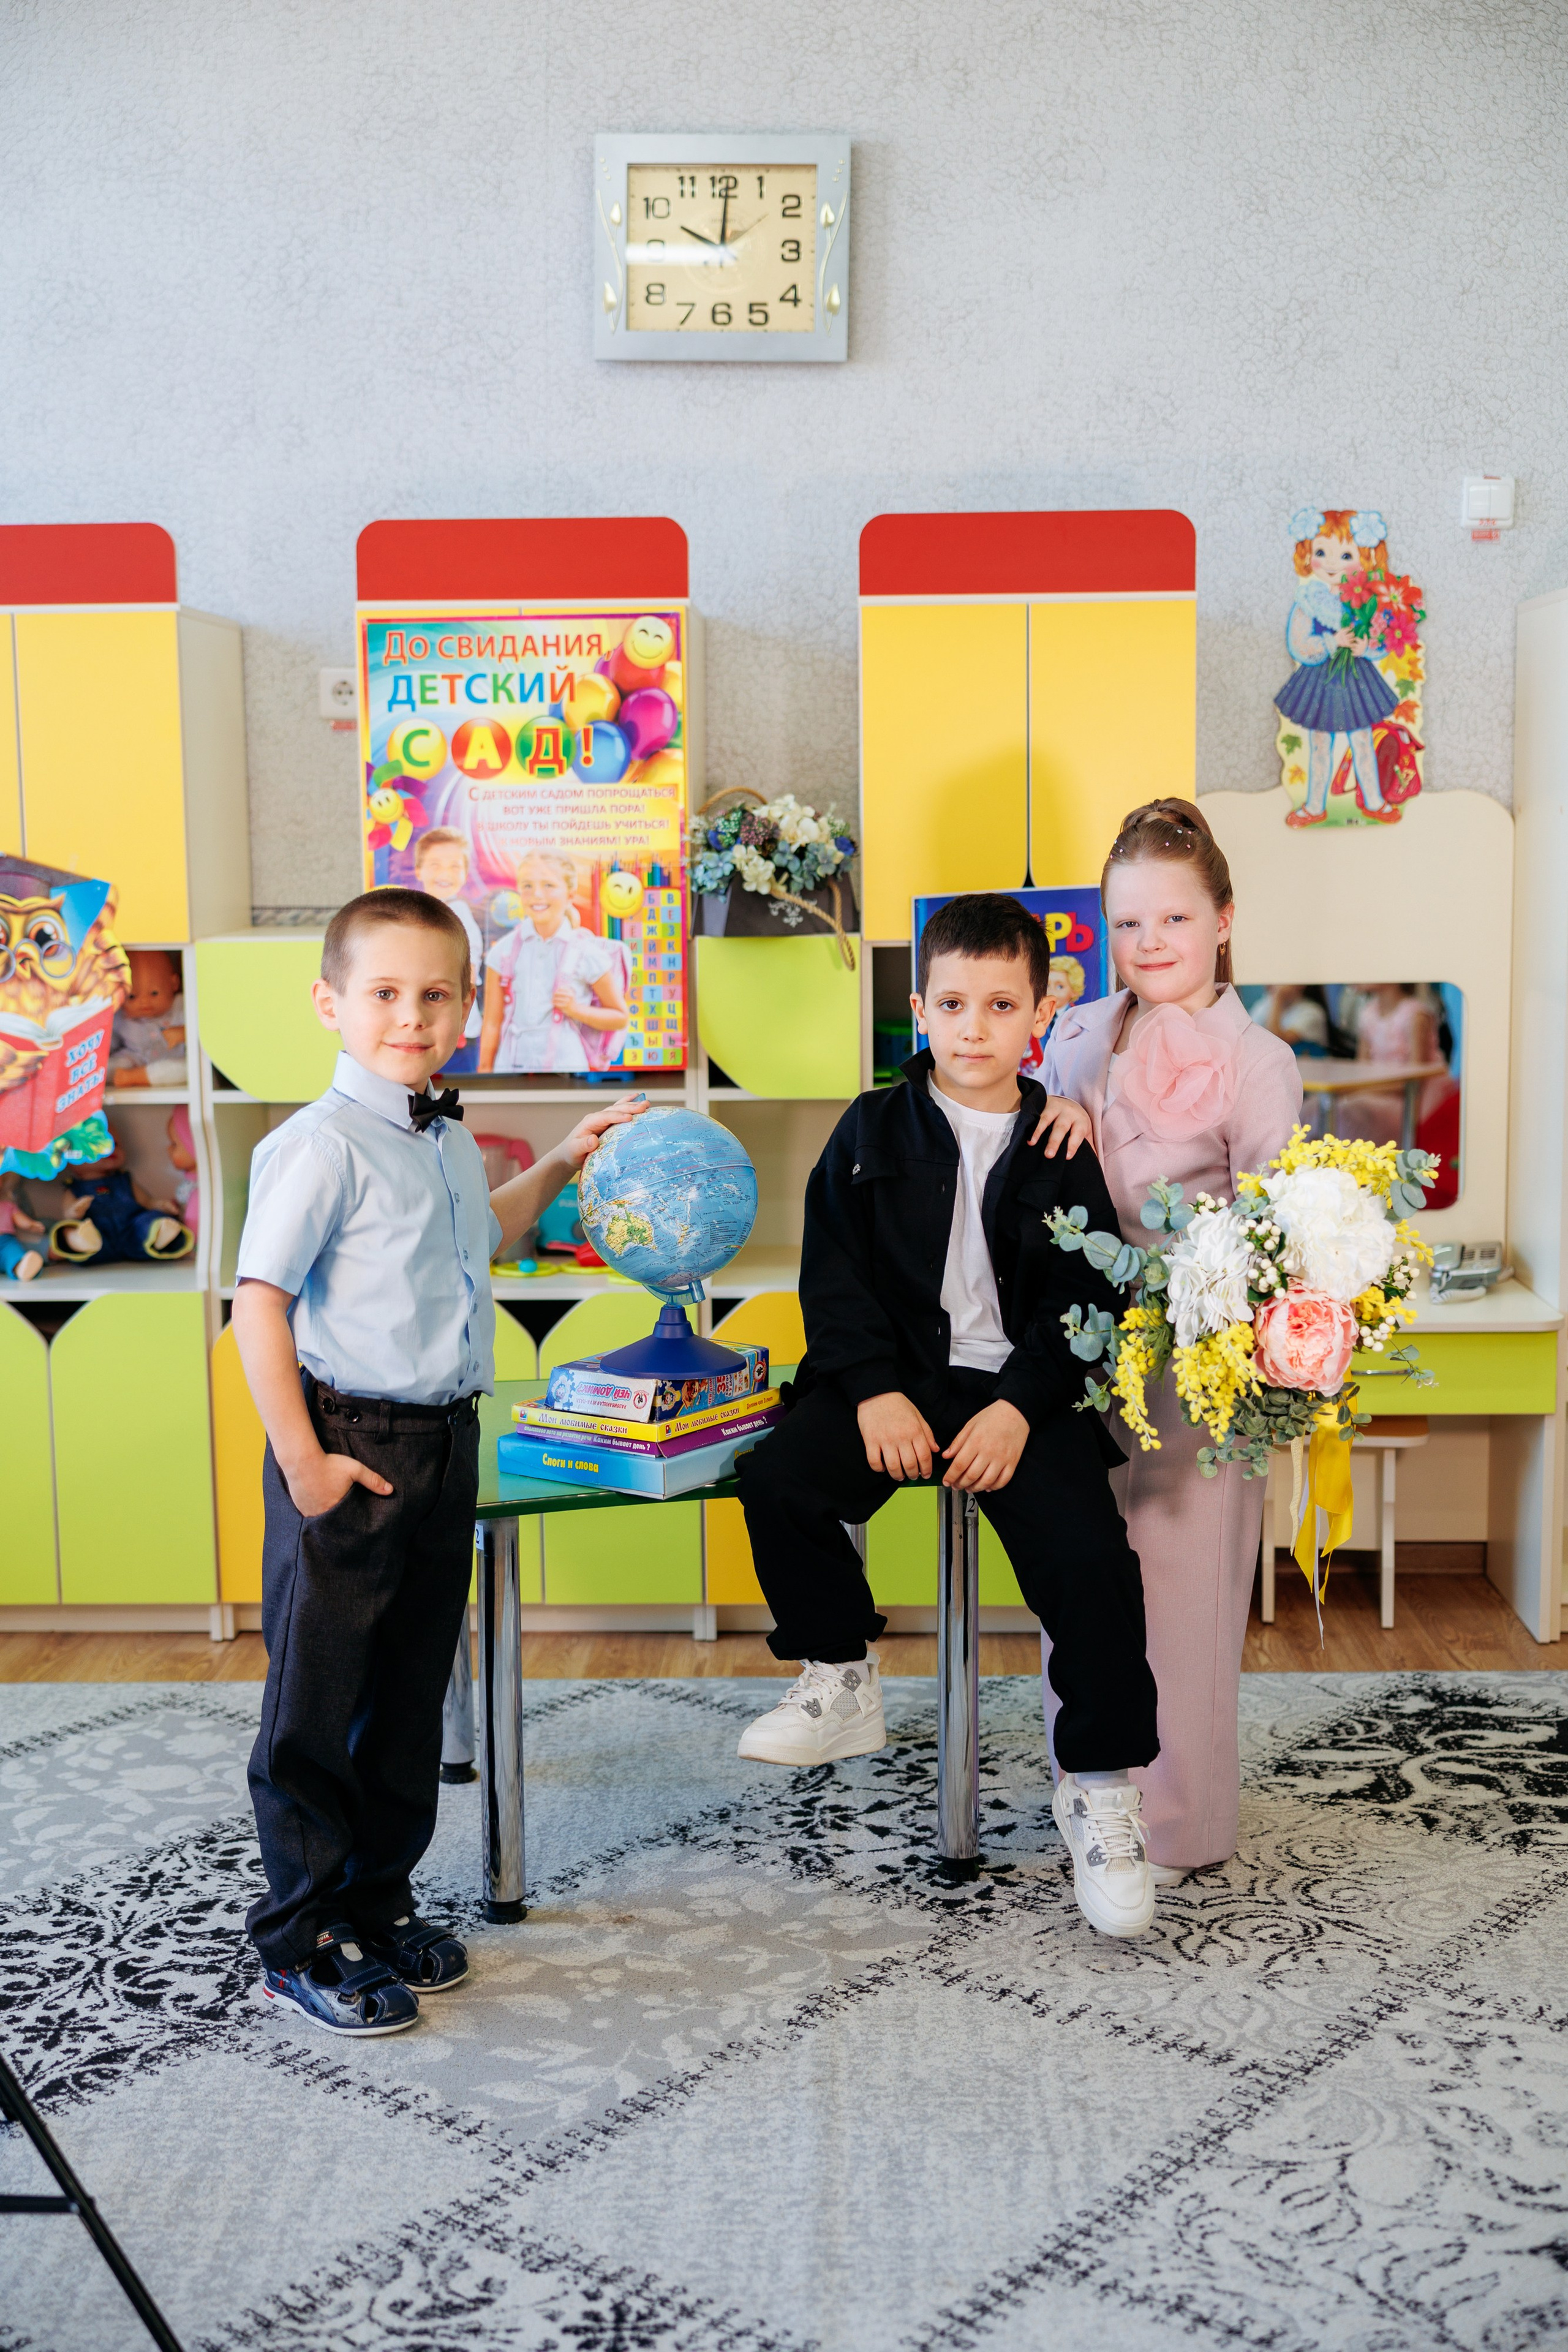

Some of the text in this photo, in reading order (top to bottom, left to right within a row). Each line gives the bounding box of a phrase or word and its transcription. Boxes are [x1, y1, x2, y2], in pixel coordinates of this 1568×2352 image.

[679, 176, 764, 198] 11 12 1
[644, 197, 670, 219] 10
[782, 195, 801, 217] 2
[782, 240, 801, 262] 3
[646, 284, 665, 305] 8
[780, 284, 801, 307] 4
[677, 303, 769, 326] 7 6 5
[439, 634, 612, 663] СВИДАНИЯ,
[387, 666, 576, 712] ДЕТСКИЙ
[468, 786, 674, 801] С ДЕТСКИМ САДОМ ПОПРОЩАТЬСЯ
[503, 804, 646, 815] ВОТ УЖЕ ПРИШЛА ПОРА!
[488, 821, 529, 832] ШКОЛУ
[532, 821, 548, 831] ТЫ
[552, 818, 611, 831] ПОЙДЕШЬ
[615, 820, 669, 829] УЧИТЬСЯ!
[560, 835, 621, 845] ЗНАНИЯМ!
[624, 835, 649, 845] УРА!
[66, 1030, 104, 1066] ХОЧУ
[56, 1068, 105, 1113] ЗНАТЬ!
[576, 1384, 630, 1399] ЧЕЙ ДОМИК?
[717, 1376, 726, 1394] 35
[538, 1413, 627, 1433] Мои любимые сказки
[675, 1408, 740, 1432] Мои любимые сказки
[721, 1427, 737, 1436] Каким
[737, 1422, 753, 1432] бывает
[753, 1419, 764, 1428] день
[562, 1431, 581, 1440] развитие
[593, 1435, 611, 1444] Каким
[612, 1438, 632, 1448] бывает
[542, 1453, 599, 1473] Слоги и слова
[967, 1498, 976, 1513] 2
